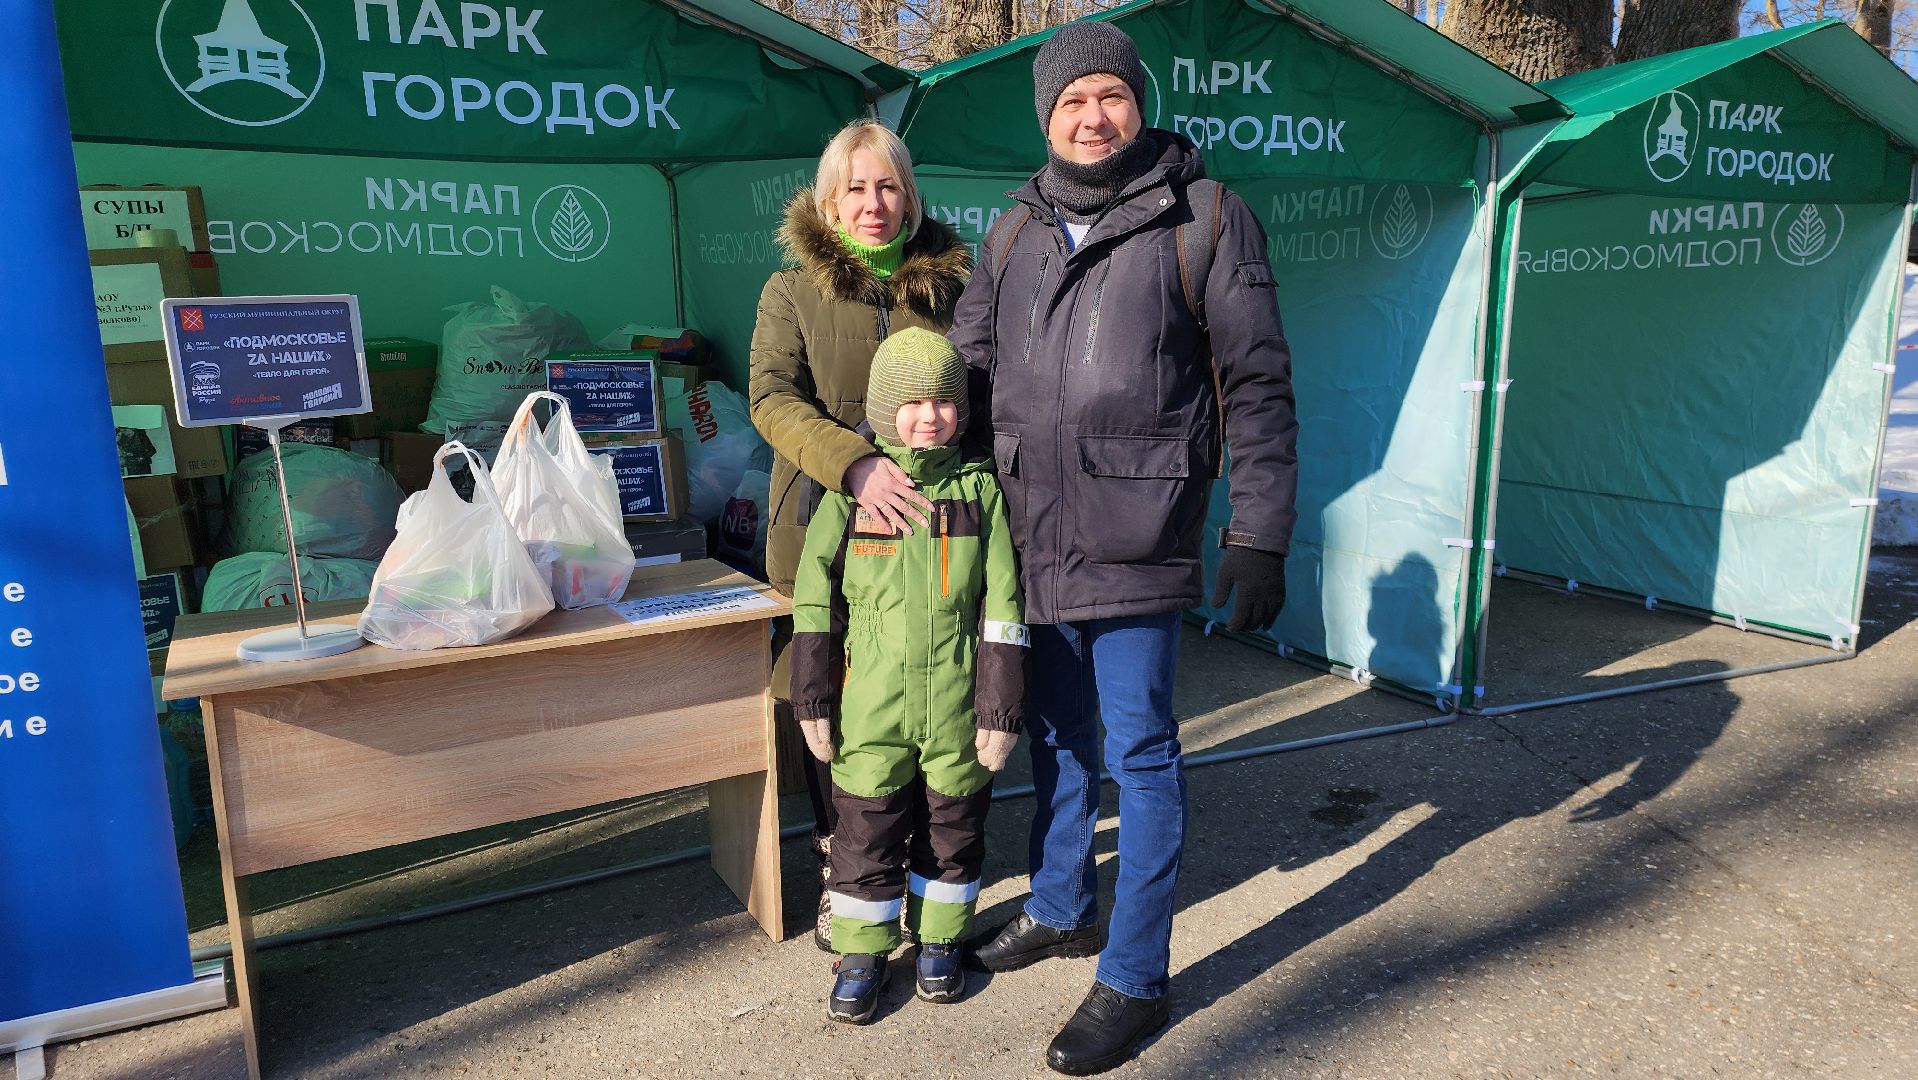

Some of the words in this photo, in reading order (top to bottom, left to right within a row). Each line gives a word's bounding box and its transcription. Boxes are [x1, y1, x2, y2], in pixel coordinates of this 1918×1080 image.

[354, 0, 548, 55] ПАРК
[1173, 56, 1273, 95] ПАРК
[362, 71, 681, 135] ГОРОДОК
[1709, 99, 1783, 134] ПАРК
[1174, 114, 1346, 156] ГОРОДОК
[1706, 146, 1834, 185] ГОРОДОК
[93, 200, 165, 214] СУПЫ
[223, 331, 347, 350] «ПОДМОСКОВЬЕ
[271, 350, 332, 364] НАШИХ»
[283, 369, 301, 378] ДЛЯ
[855, 544, 893, 554] FUTURE
